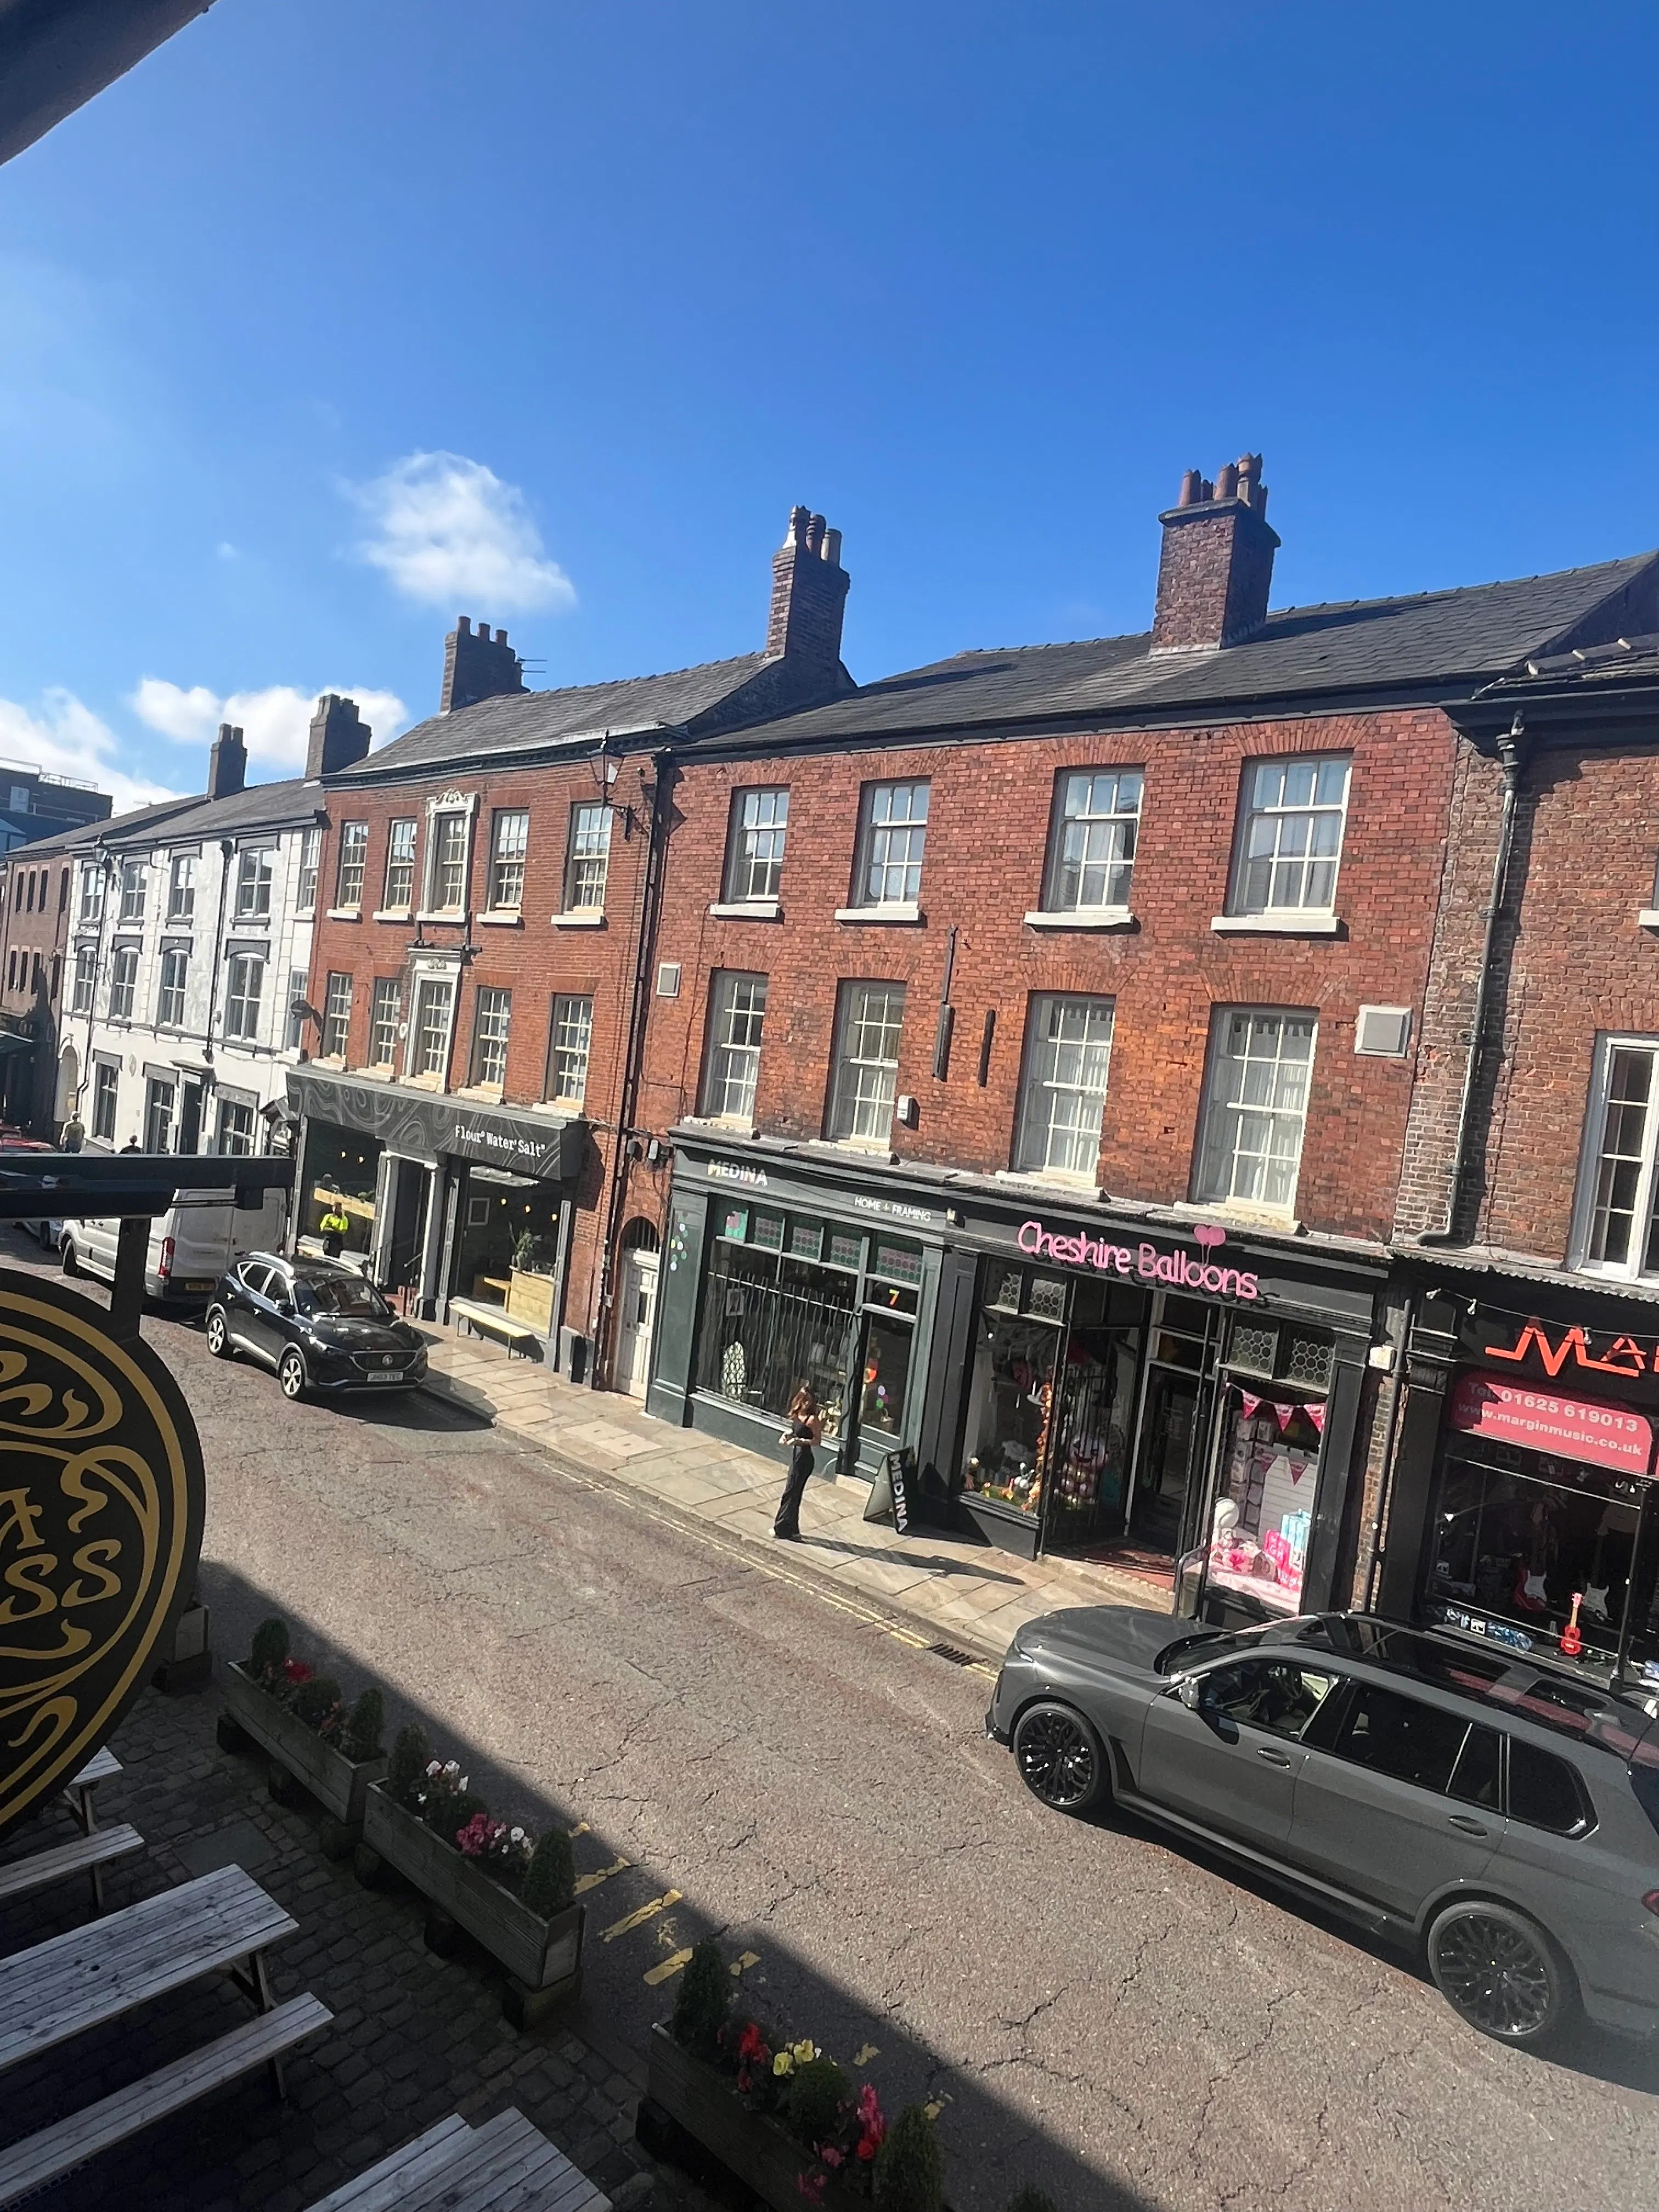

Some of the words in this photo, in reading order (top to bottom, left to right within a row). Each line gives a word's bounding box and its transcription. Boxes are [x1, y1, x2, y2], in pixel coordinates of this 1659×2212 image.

[708, 1159, 768, 1187] MEDINA
[855, 1196, 882, 1211] HOME
[892, 1204, 932, 1222] FRAMING
[1017, 1221, 1132, 1273] Cheshire
[1137, 1242, 1259, 1300] Balloons
[889, 1288, 900, 1306] 7
[1458, 1402, 1642, 1456] www.marginmusic.co.uk
[1501, 1390, 1559, 1414] 01625
[1564, 1404, 1638, 1432] 619013
[890, 1454, 908, 1532] MEDINA
